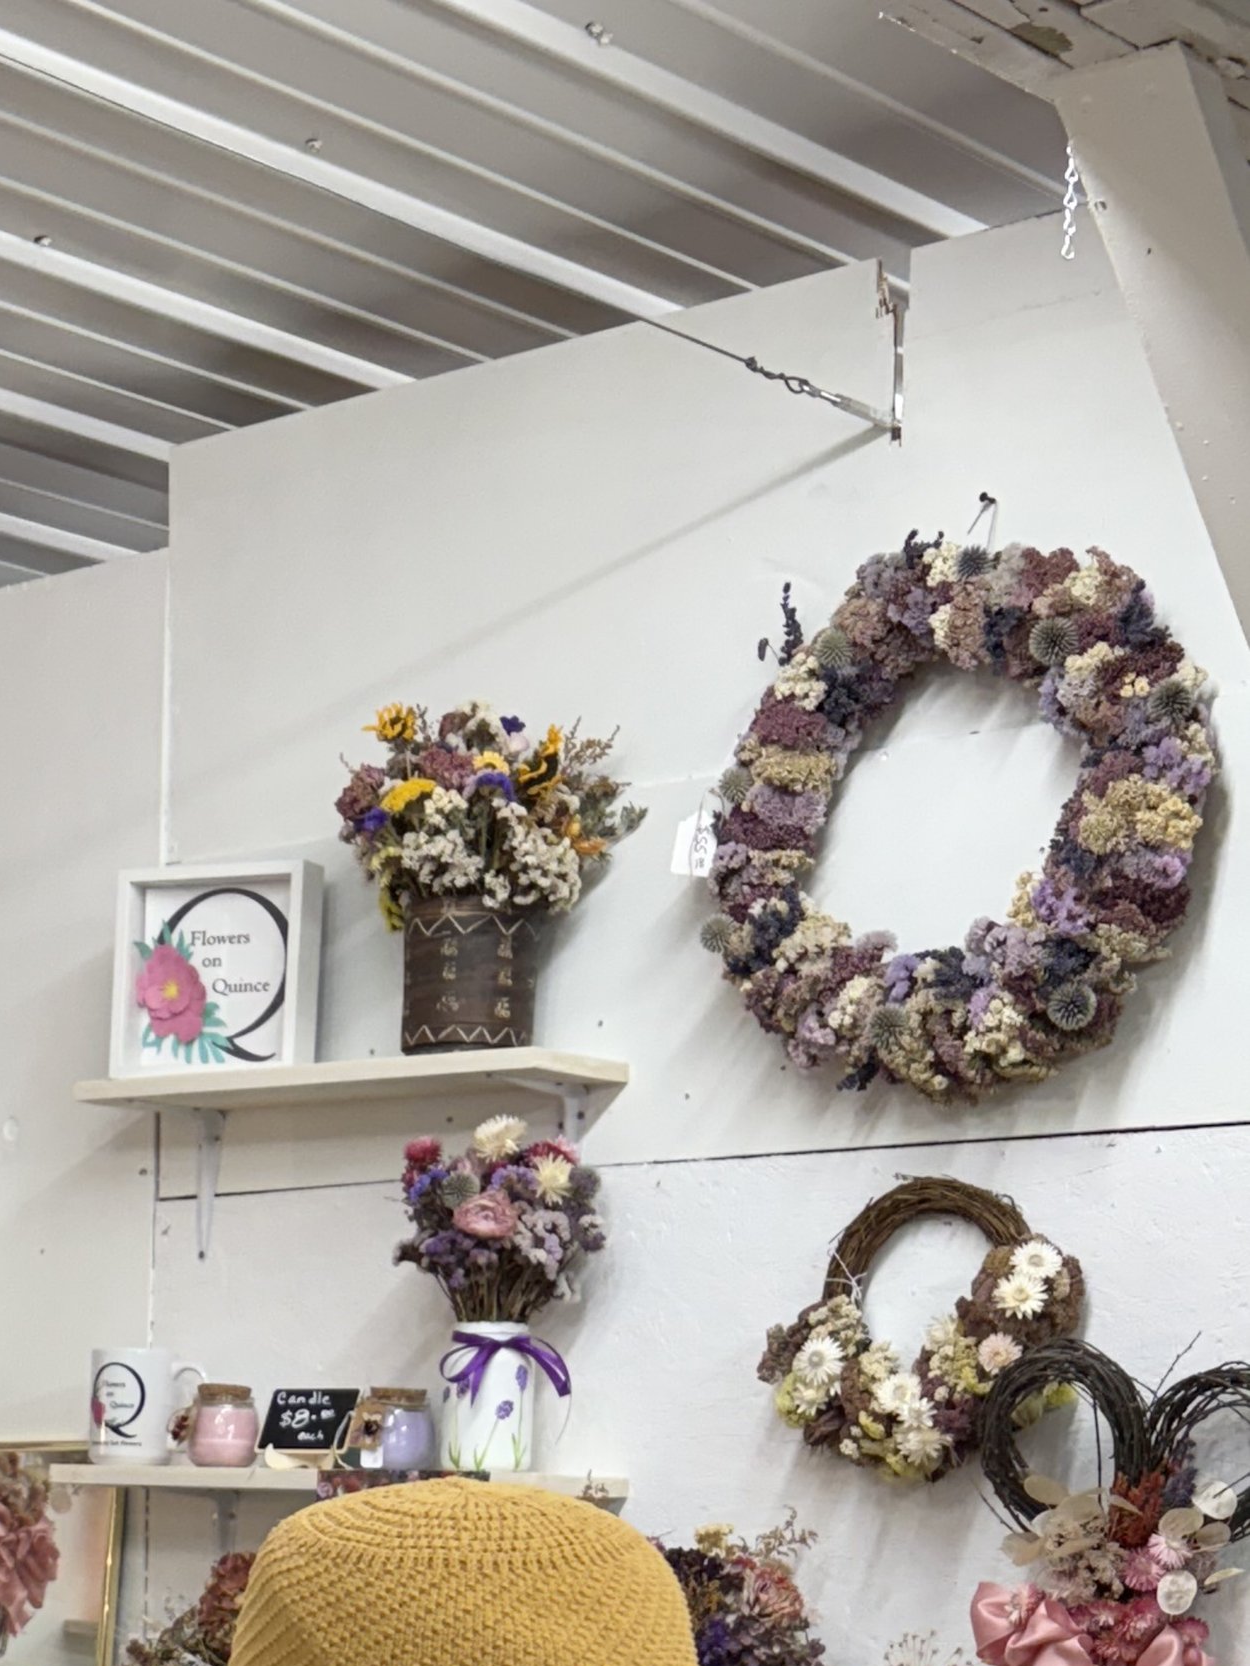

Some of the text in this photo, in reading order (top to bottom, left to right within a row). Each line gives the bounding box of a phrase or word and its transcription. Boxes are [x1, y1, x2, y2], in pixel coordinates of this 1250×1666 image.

[190, 930, 251, 947] Flowers
[202, 957, 222, 968] on
[212, 978, 270, 996] Quince
[276, 1391, 331, 1405] Candle
[297, 1429, 324, 1441] each
